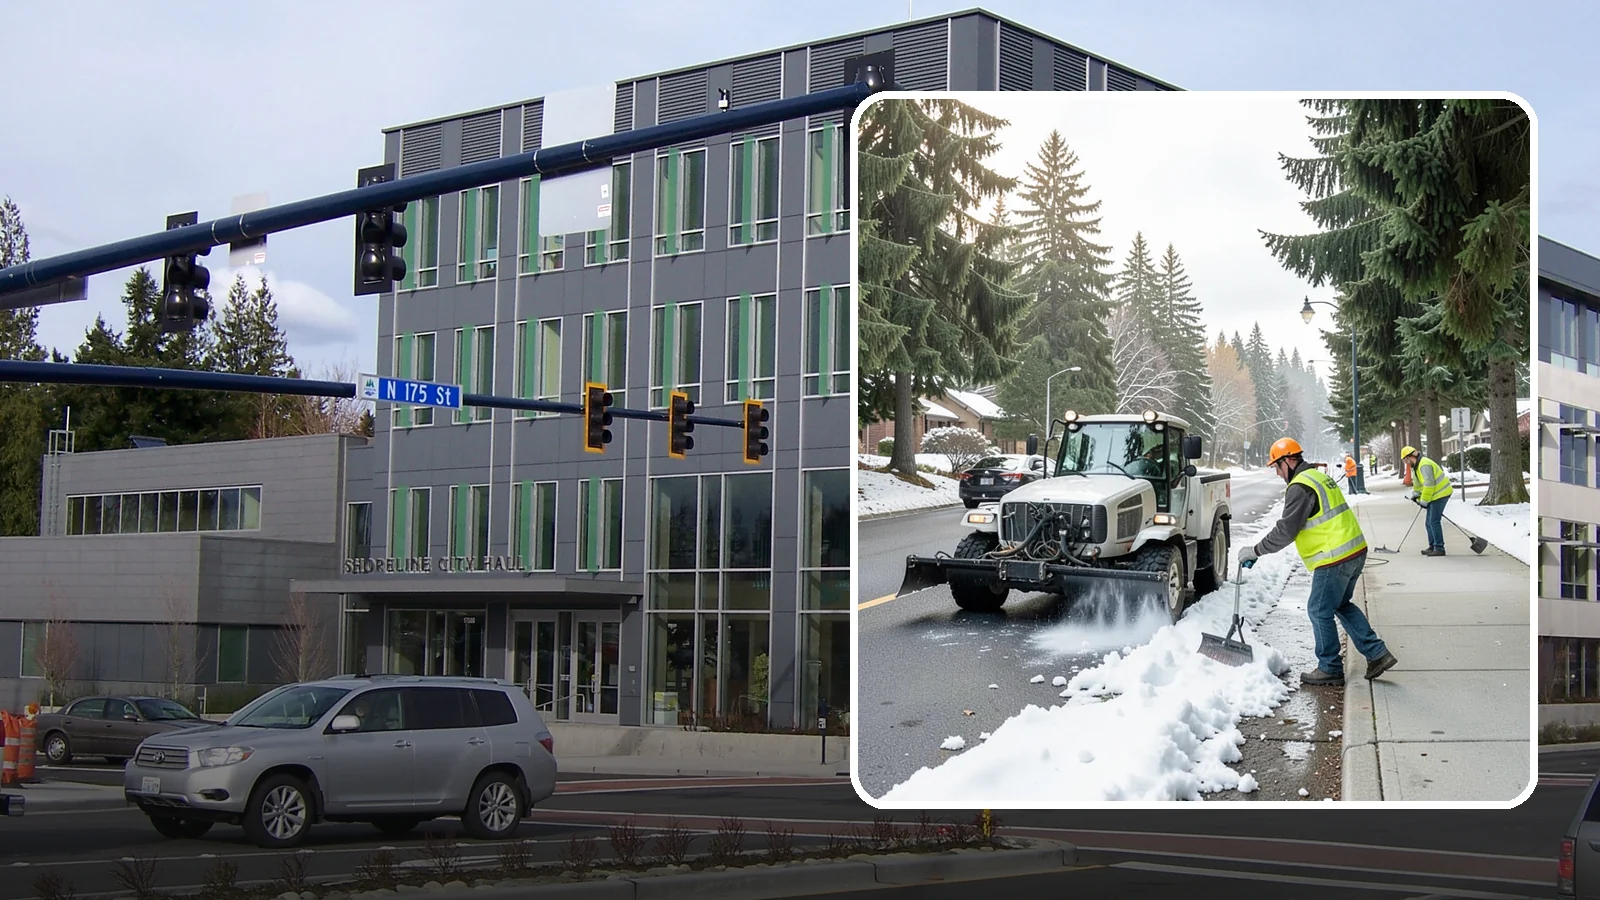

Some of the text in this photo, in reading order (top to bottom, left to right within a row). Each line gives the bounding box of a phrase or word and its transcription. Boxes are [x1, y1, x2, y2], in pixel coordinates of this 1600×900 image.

[387, 380, 452, 406] N 175 St
[343, 555, 526, 574] SHORELINE CITY HALL
